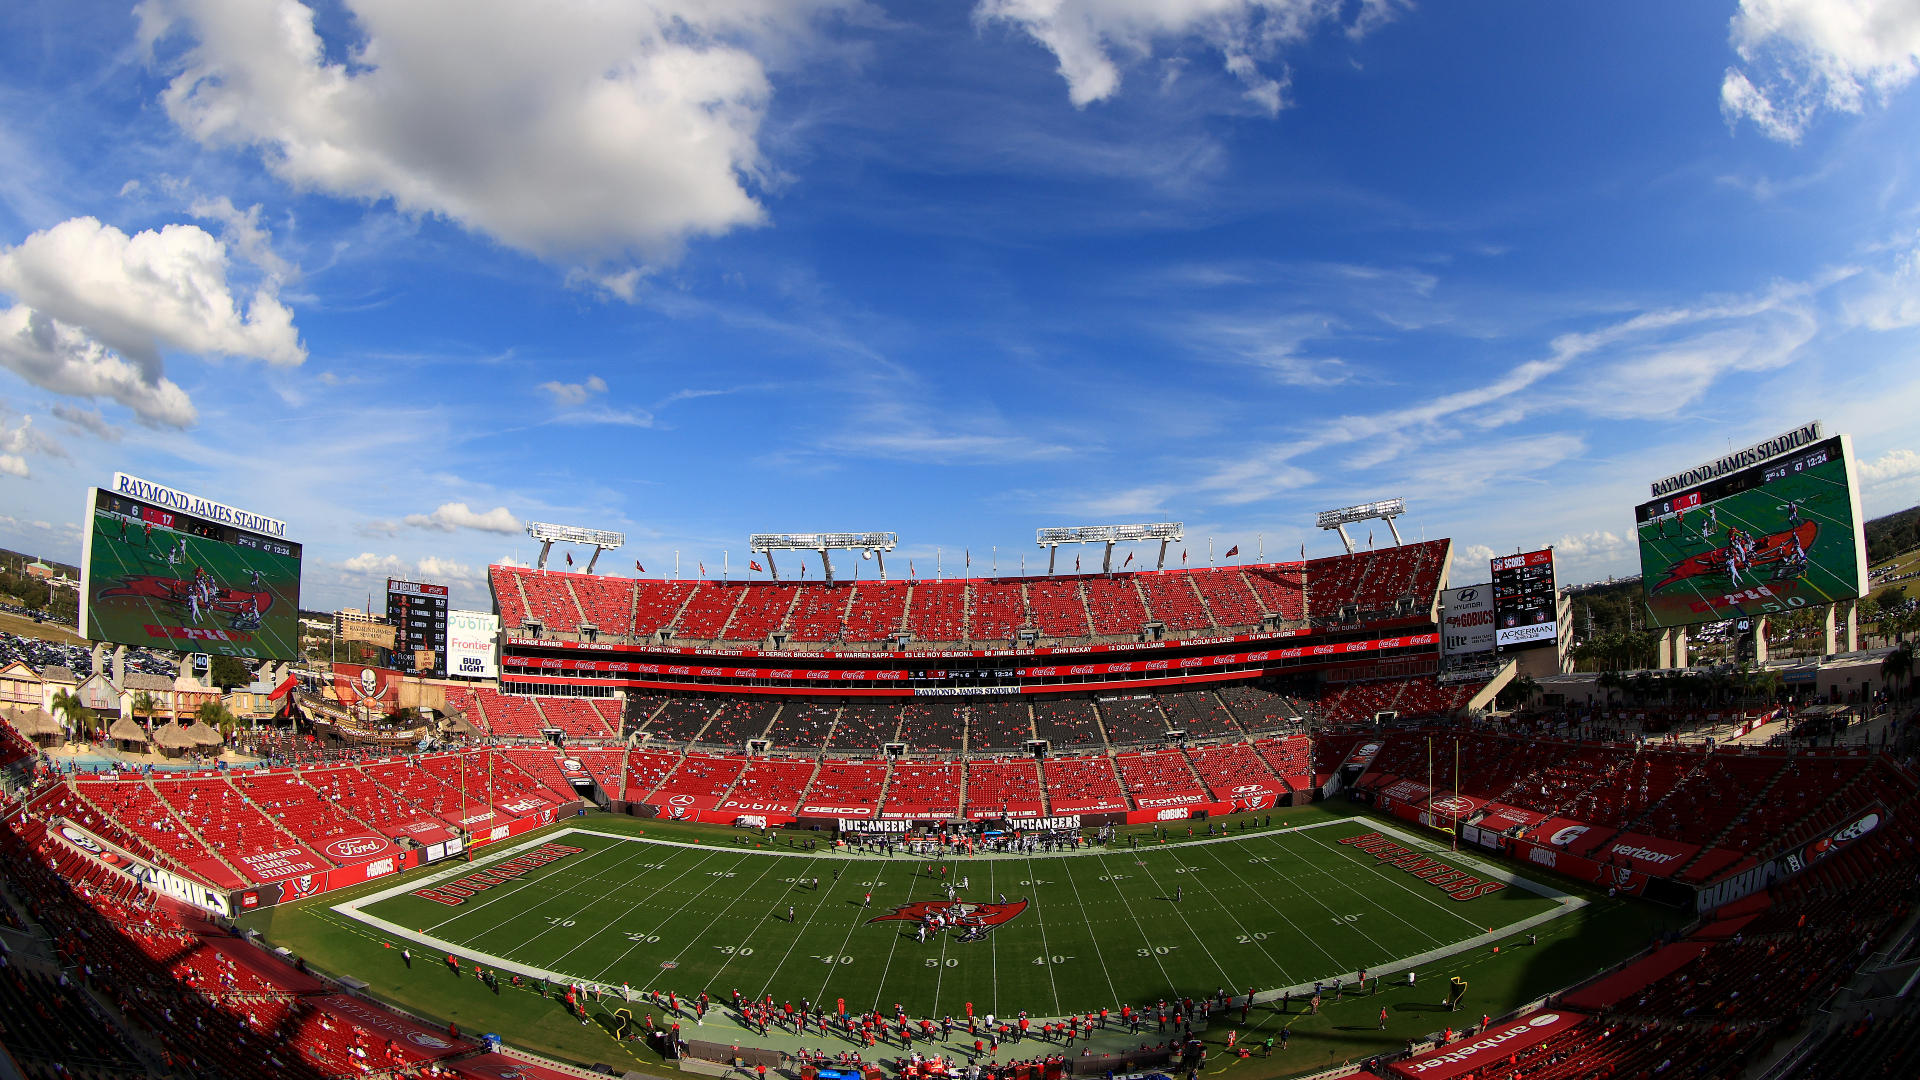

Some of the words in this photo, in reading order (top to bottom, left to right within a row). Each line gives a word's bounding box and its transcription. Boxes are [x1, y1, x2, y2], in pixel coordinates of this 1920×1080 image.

[1651, 464, 1712, 497] RAYMOND
[1714, 448, 1757, 476] JAMES
[1757, 424, 1817, 460] STADIUM
[1806, 454, 1827, 467] 12:24
[1780, 468, 1786, 477] 6
[1794, 462, 1803, 472] 47
[1688, 493, 1698, 505] 17
[119, 475, 189, 510] RAYMOND
[191, 499, 232, 522] JAMES
[233, 510, 286, 536] STADIUM
[131, 505, 139, 516] 6
[1663, 502, 1670, 512] 6
[162, 514, 173, 525] 17
[251, 540, 257, 548] 6
[263, 544, 271, 552] 47
[273, 545, 290, 556] 12:24
[1504, 556, 1526, 569] SCORES
[1454, 601, 1483, 611] HYUNDAI
[448, 615, 494, 631] Publix
[1326, 625, 1341, 633] TONY
[1342, 624, 1361, 632] DUNGY
[1737, 620, 1749, 630] 40
[1270, 630, 1296, 639] GRUBER
[1500, 625, 1553, 640] ACKERMAN
[452, 637, 492, 651] Frontier
[1116, 643, 1135, 651] DOUG
[1136, 642, 1165, 650] WILLIAMS
[1180, 638, 1206, 646] MALCOLM
[1206, 636, 1235, 645] GLAZER
[1446, 635, 1467, 650] Lite
[196, 656, 207, 666] 40
[463, 657, 482, 666] BUD
[459, 664, 485, 673] LIGHT
[915, 688, 956, 696] RAYMOND
[957, 687, 984, 695] JAMES
[985, 686, 1021, 695] STADIUM
[1230, 789, 1273, 798] HYUNDAI
[1138, 794, 1204, 806] Frontier
[724, 801, 788, 812] Publix
[803, 806, 871, 815] GEICO
[1157, 807, 1188, 820] #GOBUCS
[838, 819, 913, 832] BUCCANEERS
[338, 839, 380, 856] Ford
[240, 848, 302, 865] RAYMOND
[1528, 846, 1557, 868] #GOBUCS
[1611, 843, 1669, 865] verizon
[252, 858, 292, 871] JAMES
[257, 861, 316, 880] STADIUM
[1337, 831, 1508, 901] BUCCANEERS
[407, 842, 586, 907] BUCCANEERS
[547, 917, 577, 928] 10
[1330, 913, 1358, 926] 10
[627, 931, 661, 944] 20
[1235, 931, 1268, 944] 20
[720, 945, 754, 957] 30
[1136, 945, 1170, 957] 30
[819, 953, 854, 965] 40
[925, 957, 959, 968] 50
[1031, 954, 1065, 966] 40
